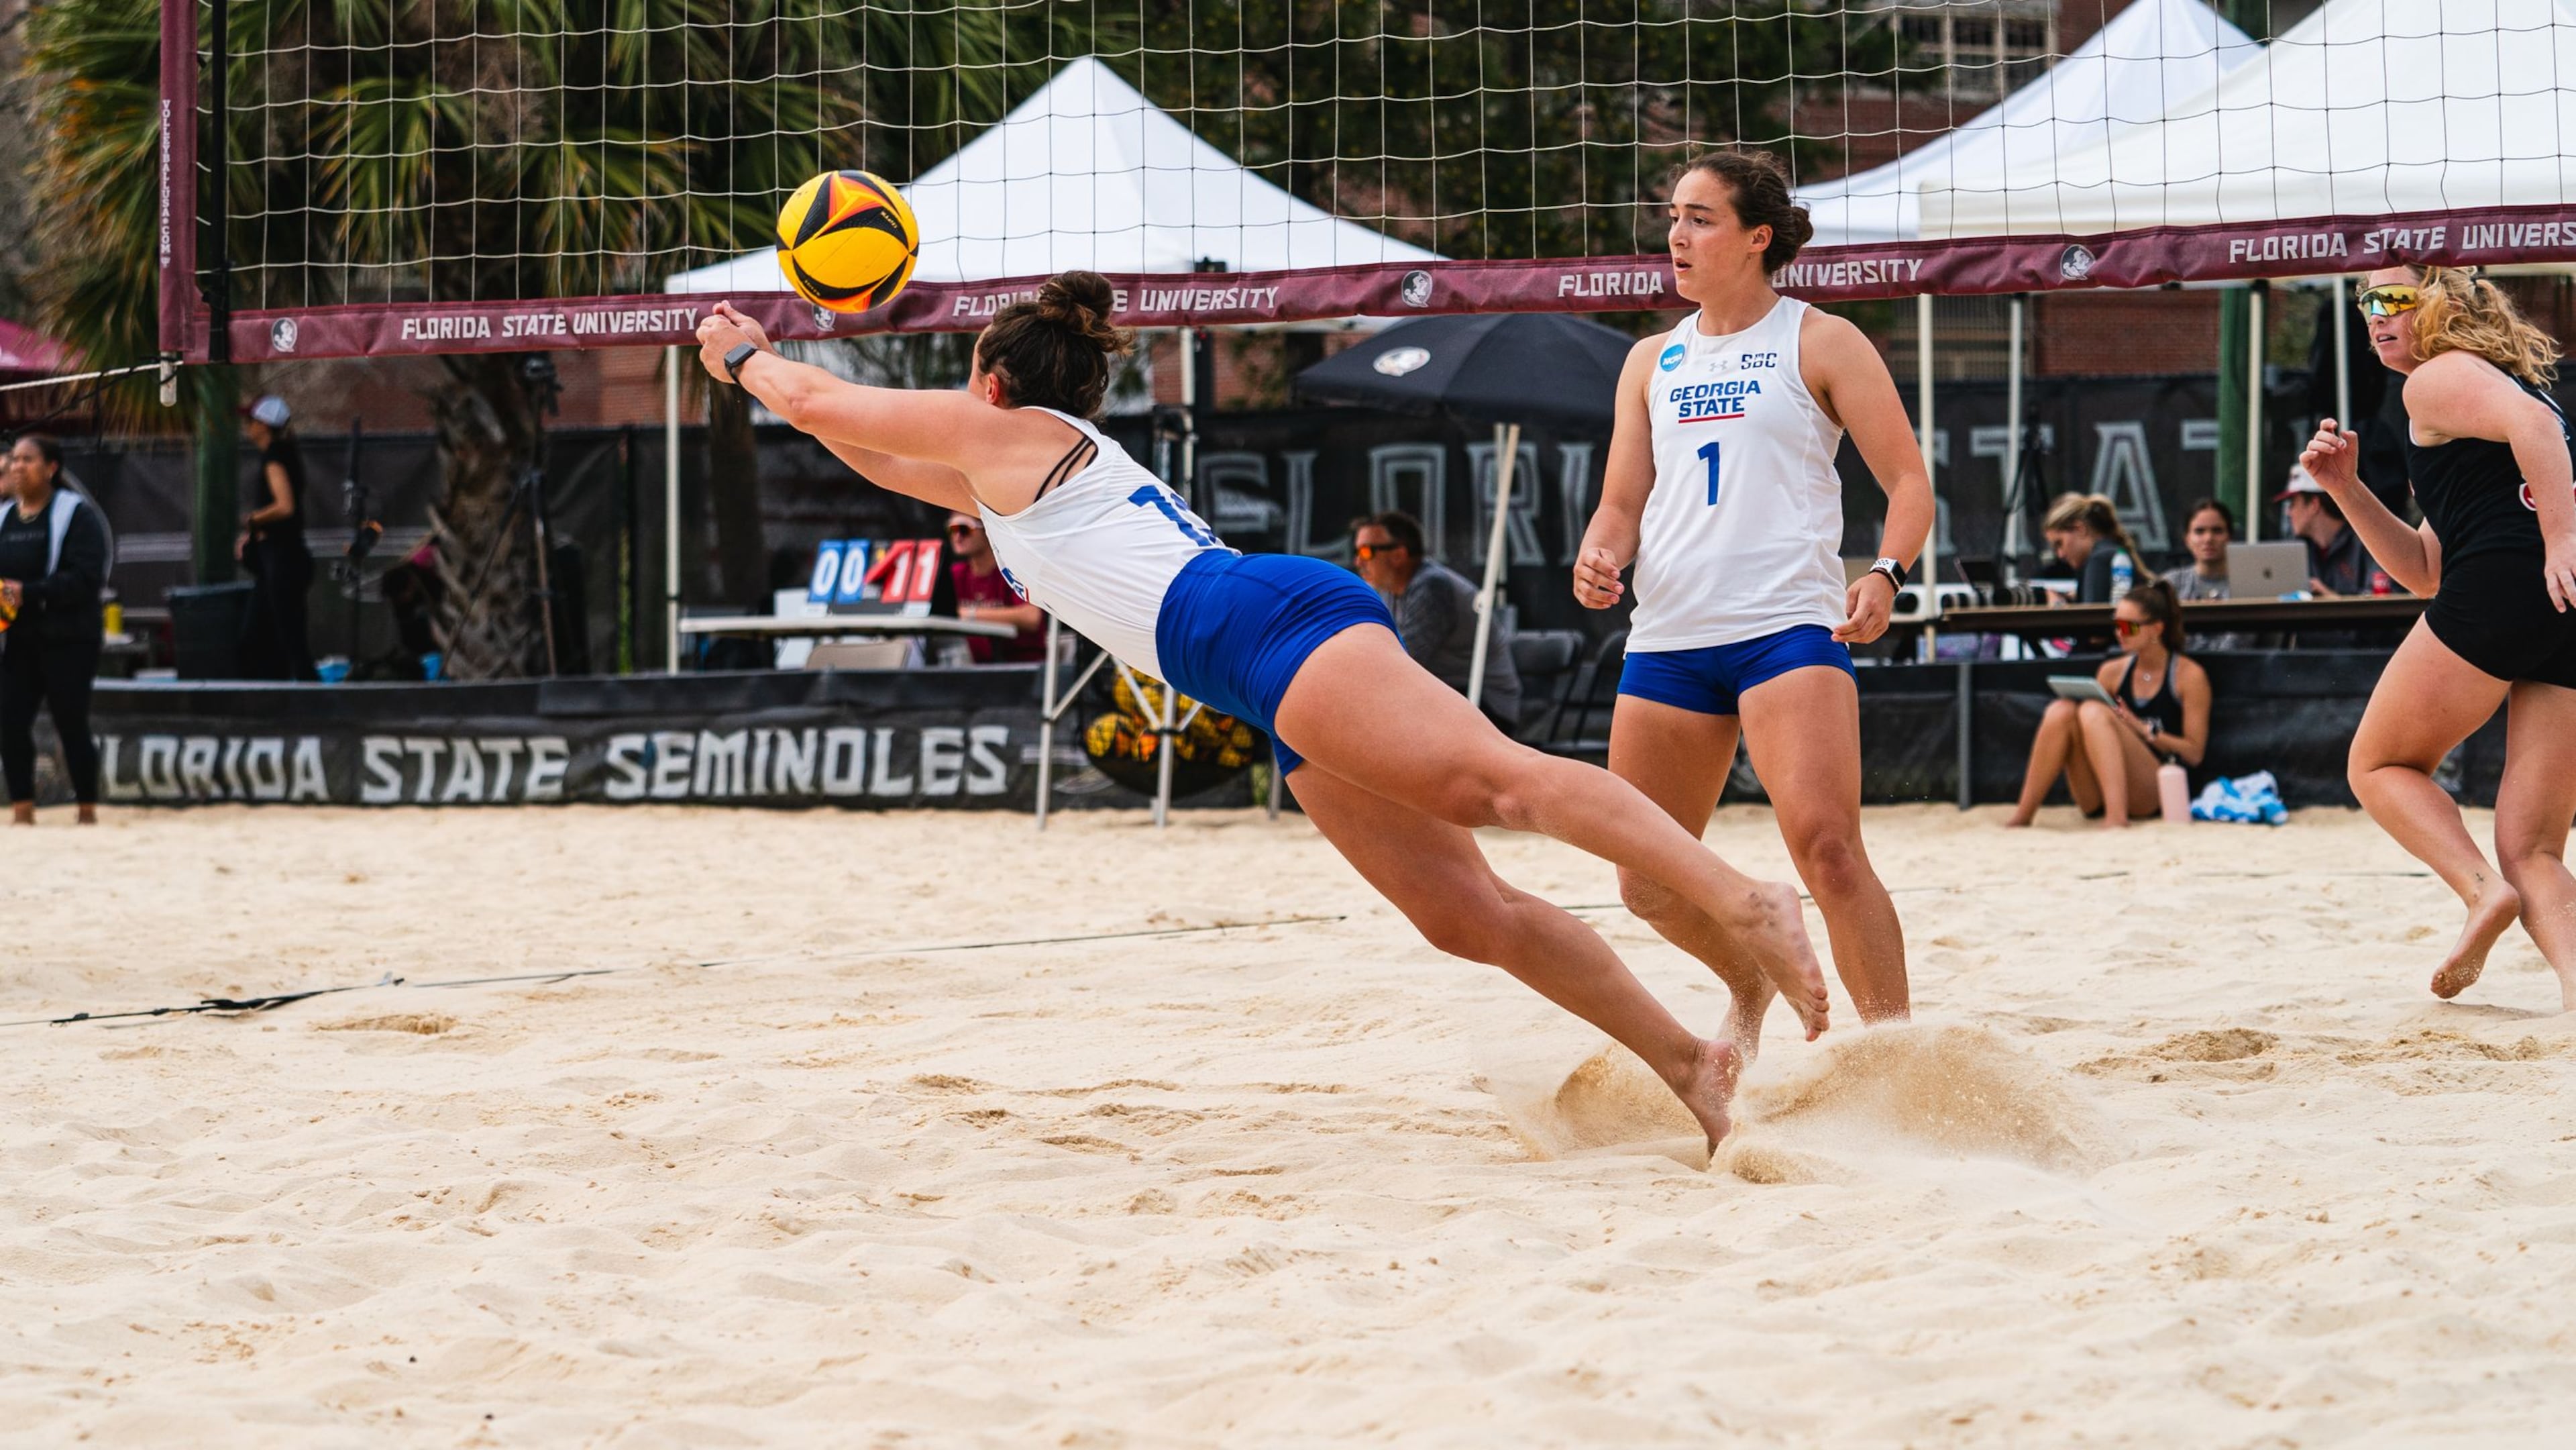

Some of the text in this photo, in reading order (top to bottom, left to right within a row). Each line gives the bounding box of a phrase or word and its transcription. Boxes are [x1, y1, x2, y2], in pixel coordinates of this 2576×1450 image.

[2229, 221, 2576, 264] FLORIDA STATE UNIVERS
[1558, 258, 1924, 298] FLORIDA UNIVERSITY
[952, 291, 1034, 317] FLORI
[1140, 286, 1279, 311] UNIVERSITY
[401, 308, 698, 340] FLORIDA STATE UNIVERSITY
[1670, 380, 1762, 403] GEORGIA
[1678, 397, 1746, 417] STATE
[1697, 442, 1720, 506] 1
[1128, 484, 1217, 548] 1
[1197, 442, 1595, 566] FLORI
[812, 547, 936, 597] 00 11
[93, 725, 1010, 802] LORIDA STATE SEMINOLES
